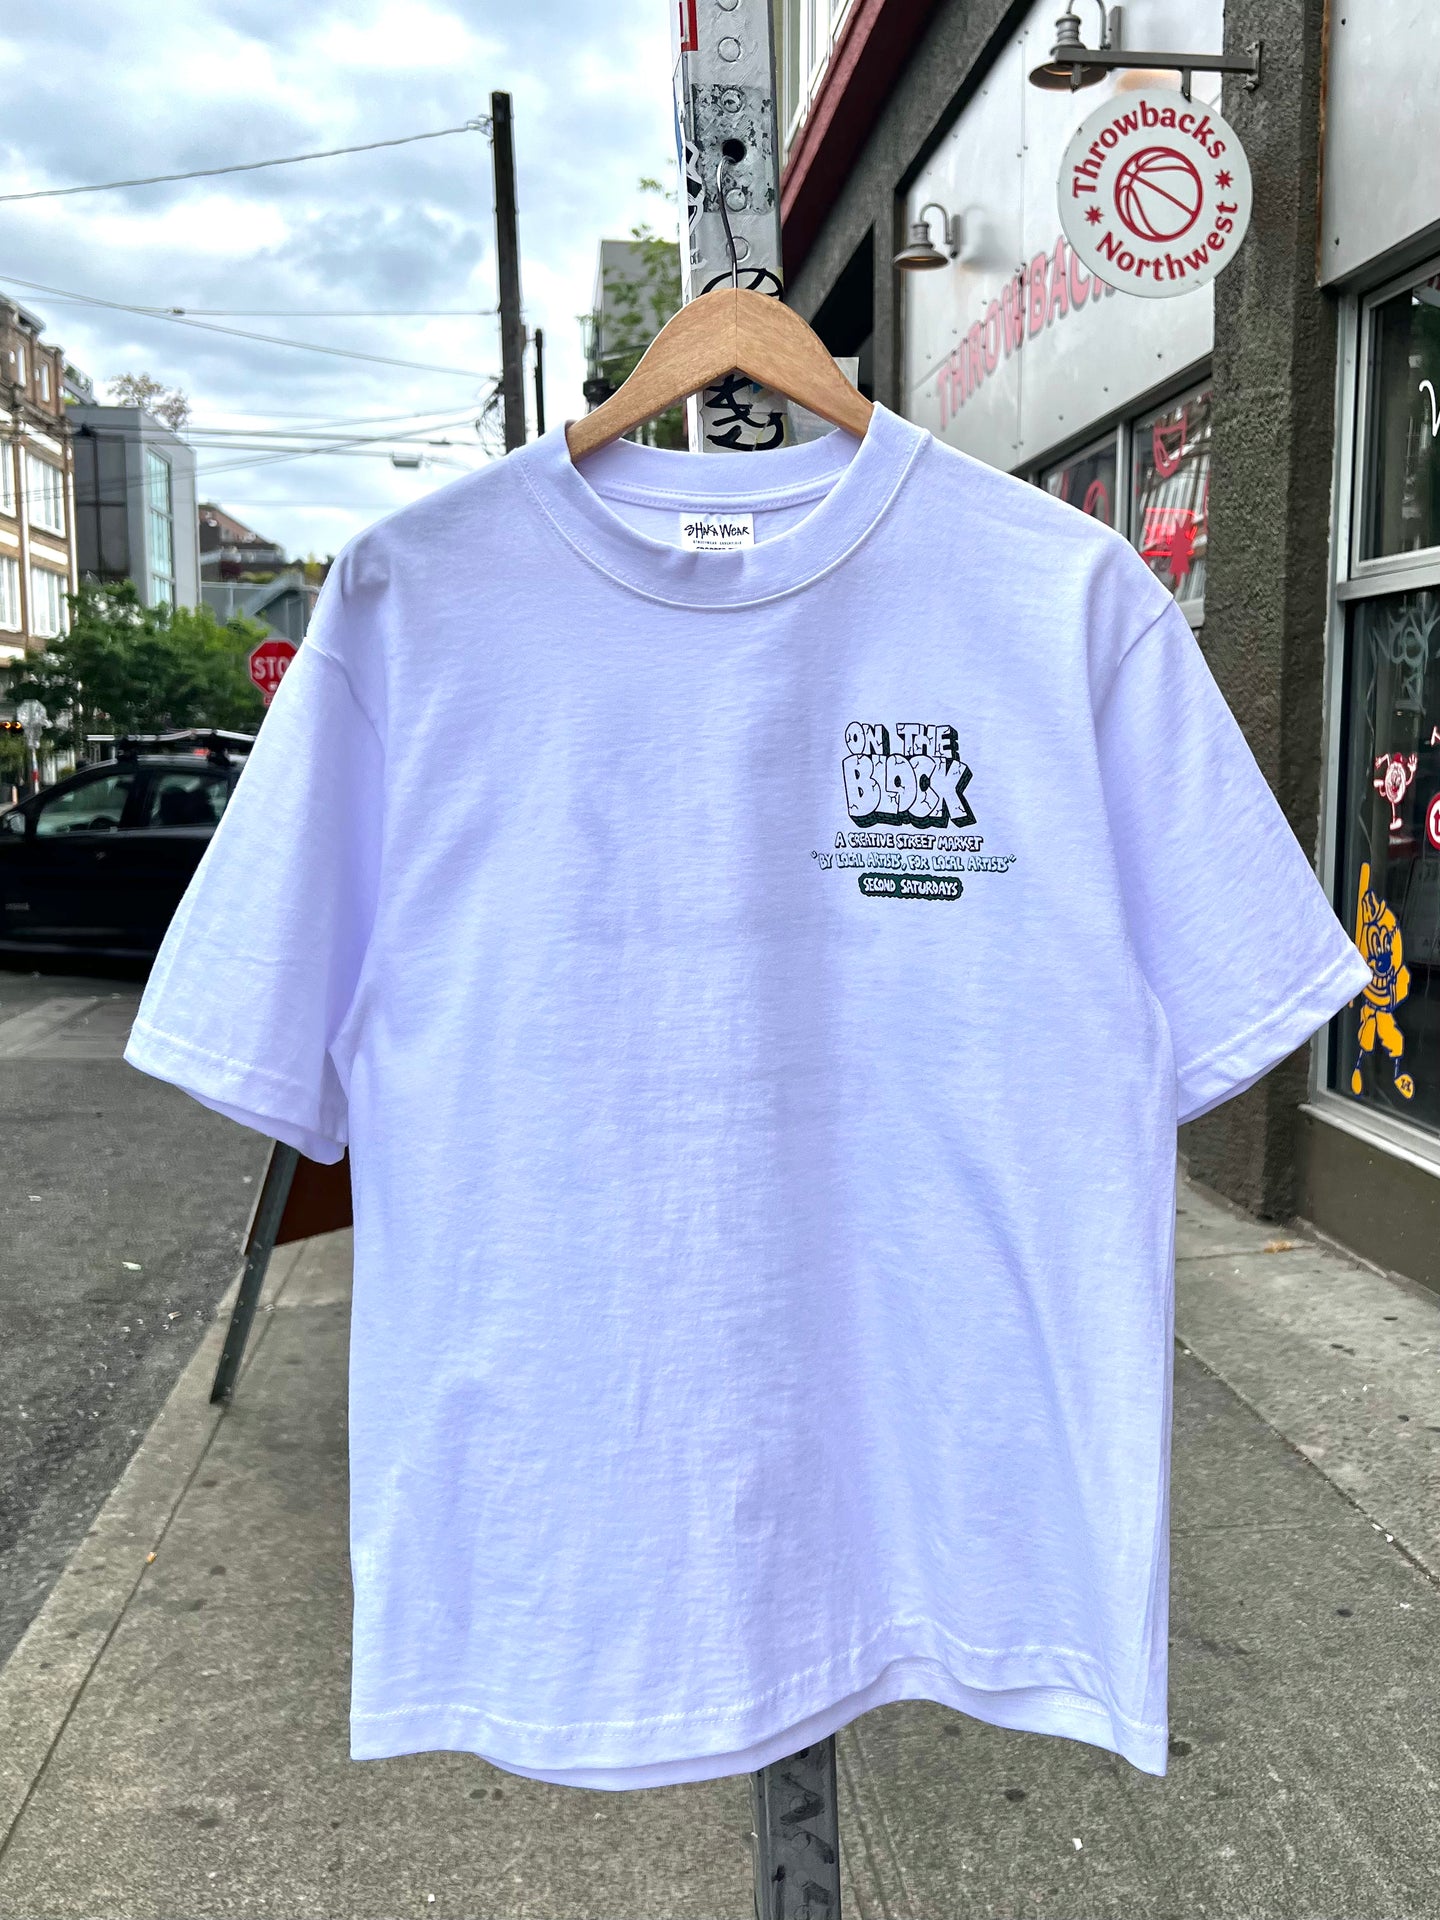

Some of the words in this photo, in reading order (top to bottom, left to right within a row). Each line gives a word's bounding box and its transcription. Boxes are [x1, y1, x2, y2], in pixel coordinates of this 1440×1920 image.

[1072, 100, 1227, 199] Throwbacks
[1095, 201, 1239, 281] Northwest
[937, 235, 1116, 431] THROWBAC
[253, 656, 293, 679] STO
[845, 721, 890, 755] ON
[896, 723, 960, 761] THE
[842, 753, 977, 829] BLOCK
[834, 832, 845, 848] A
[847, 833, 895, 848] CREATIVE
[895, 834, 936, 850] STREET
[937, 836, 984, 851] MARKET
[835, 852, 865, 869] LOCAL
[908, 855, 930, 870] FOR
[932, 855, 965, 872] LOCAL
[863, 877, 896, 893] SECOND
[900, 878, 959, 897] SATURDAYS
